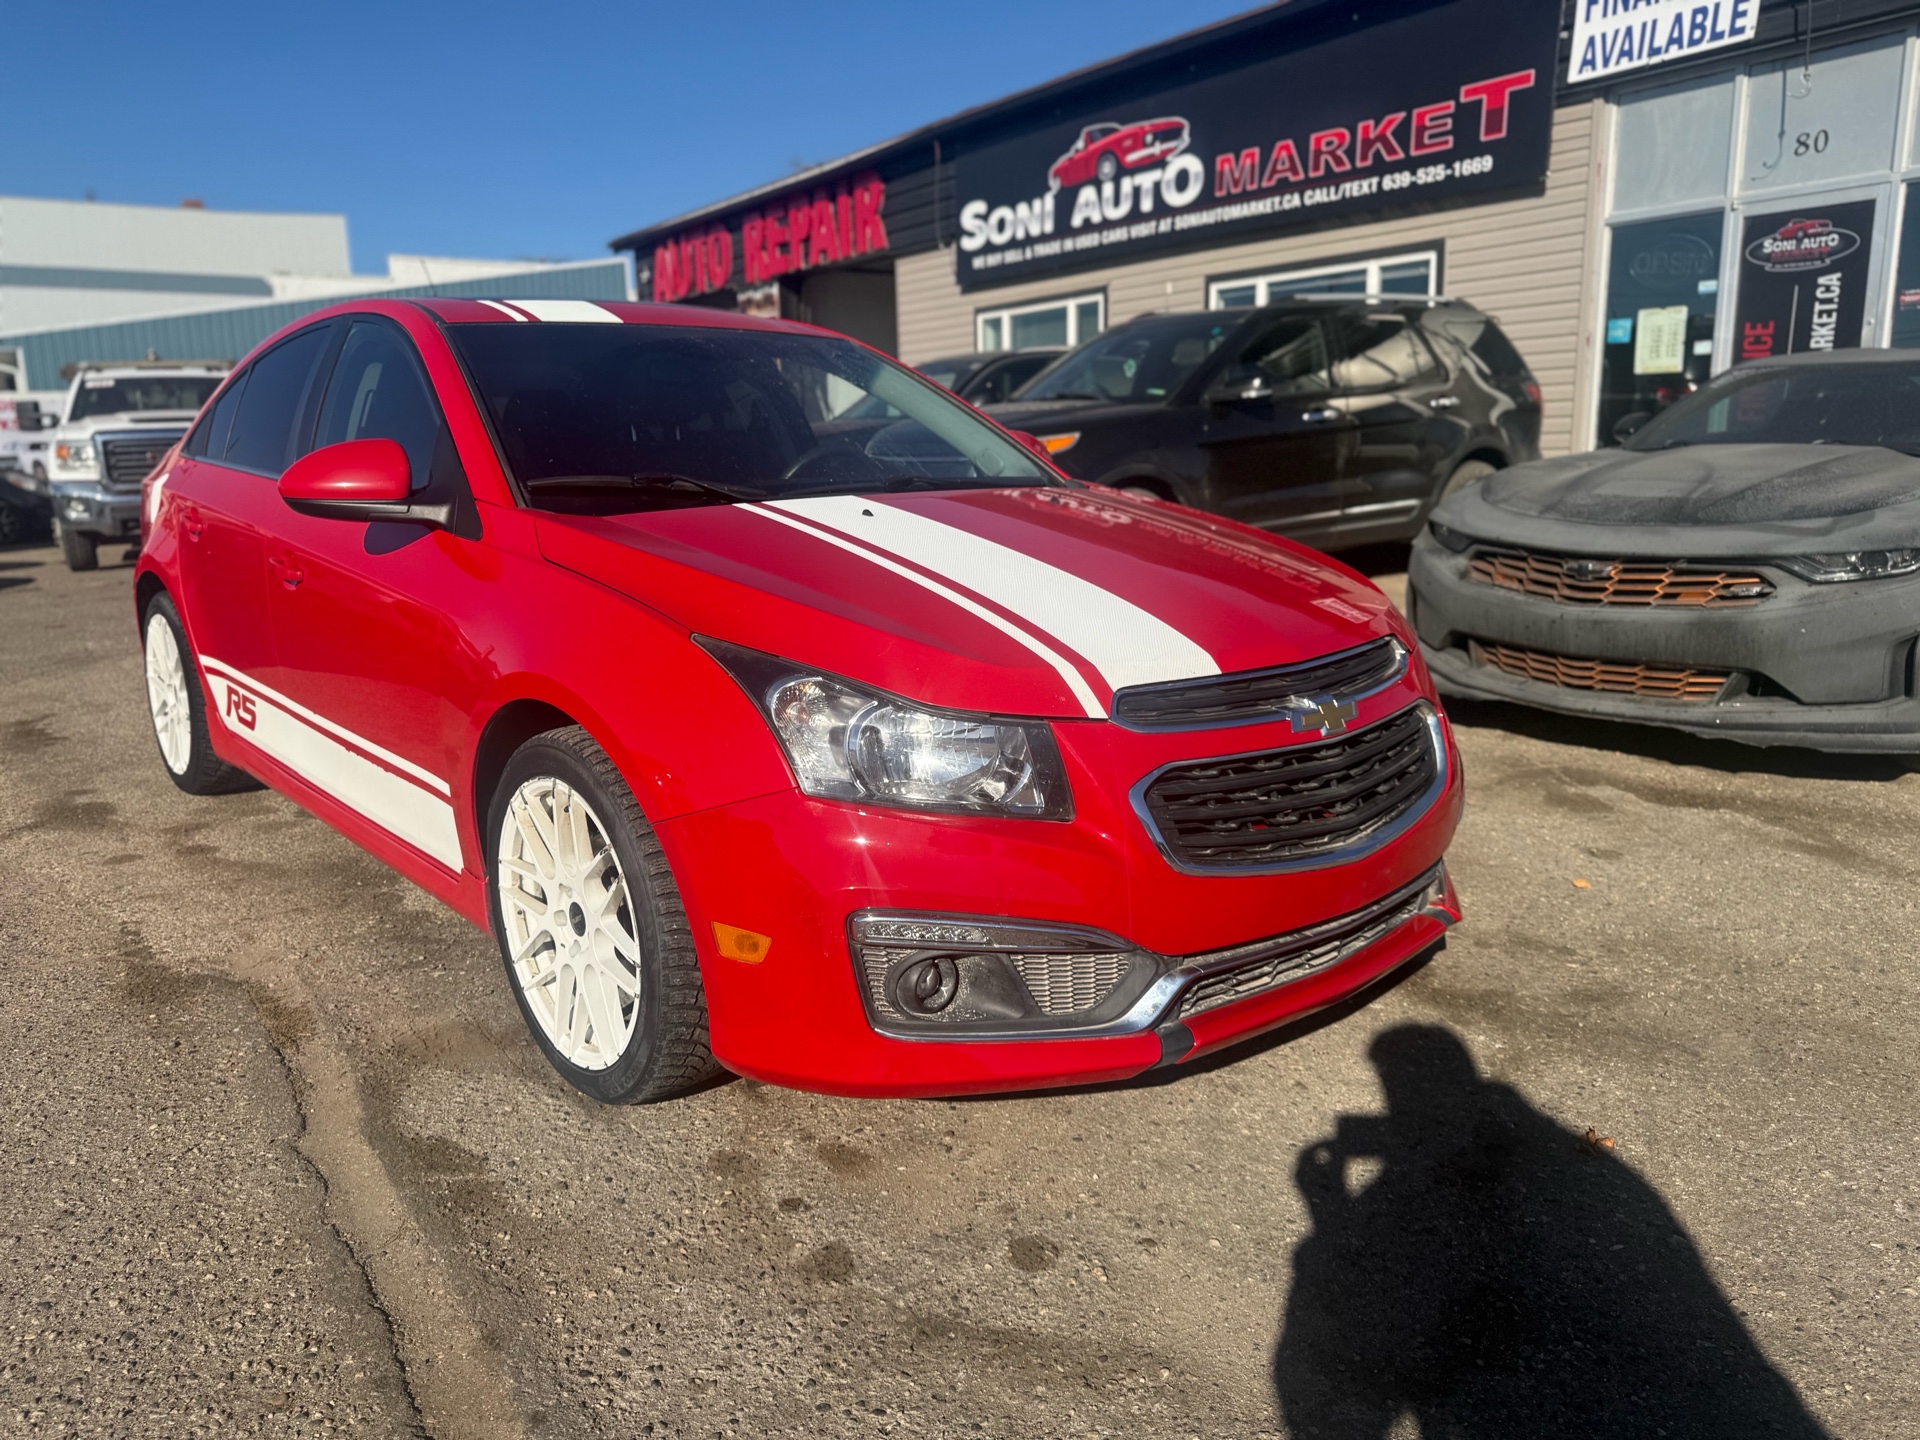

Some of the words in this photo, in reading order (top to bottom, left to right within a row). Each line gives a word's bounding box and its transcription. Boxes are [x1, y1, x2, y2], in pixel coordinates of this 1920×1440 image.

[1578, 0, 1749, 75] AVAILABLE
[959, 190, 1055, 251] SONI
[1070, 153, 1205, 228] AUTO
[1214, 68, 1536, 197] MARKET
[1793, 129, 1829, 157] 80
[1100, 227, 1128, 245] CARS
[1157, 218, 1173, 233] AT
[1302, 176, 1380, 207] CALL/TEXT
[1381, 154, 1494, 191] 639-525-1669
[653, 229, 732, 302] AUTO
[743, 179, 888, 284] REPAIR
[1762, 238, 1796, 254] SONI
[1801, 233, 1840, 250] AUTO
[1809, 272, 1843, 352] RKET.CA
[226, 683, 257, 732] RS
